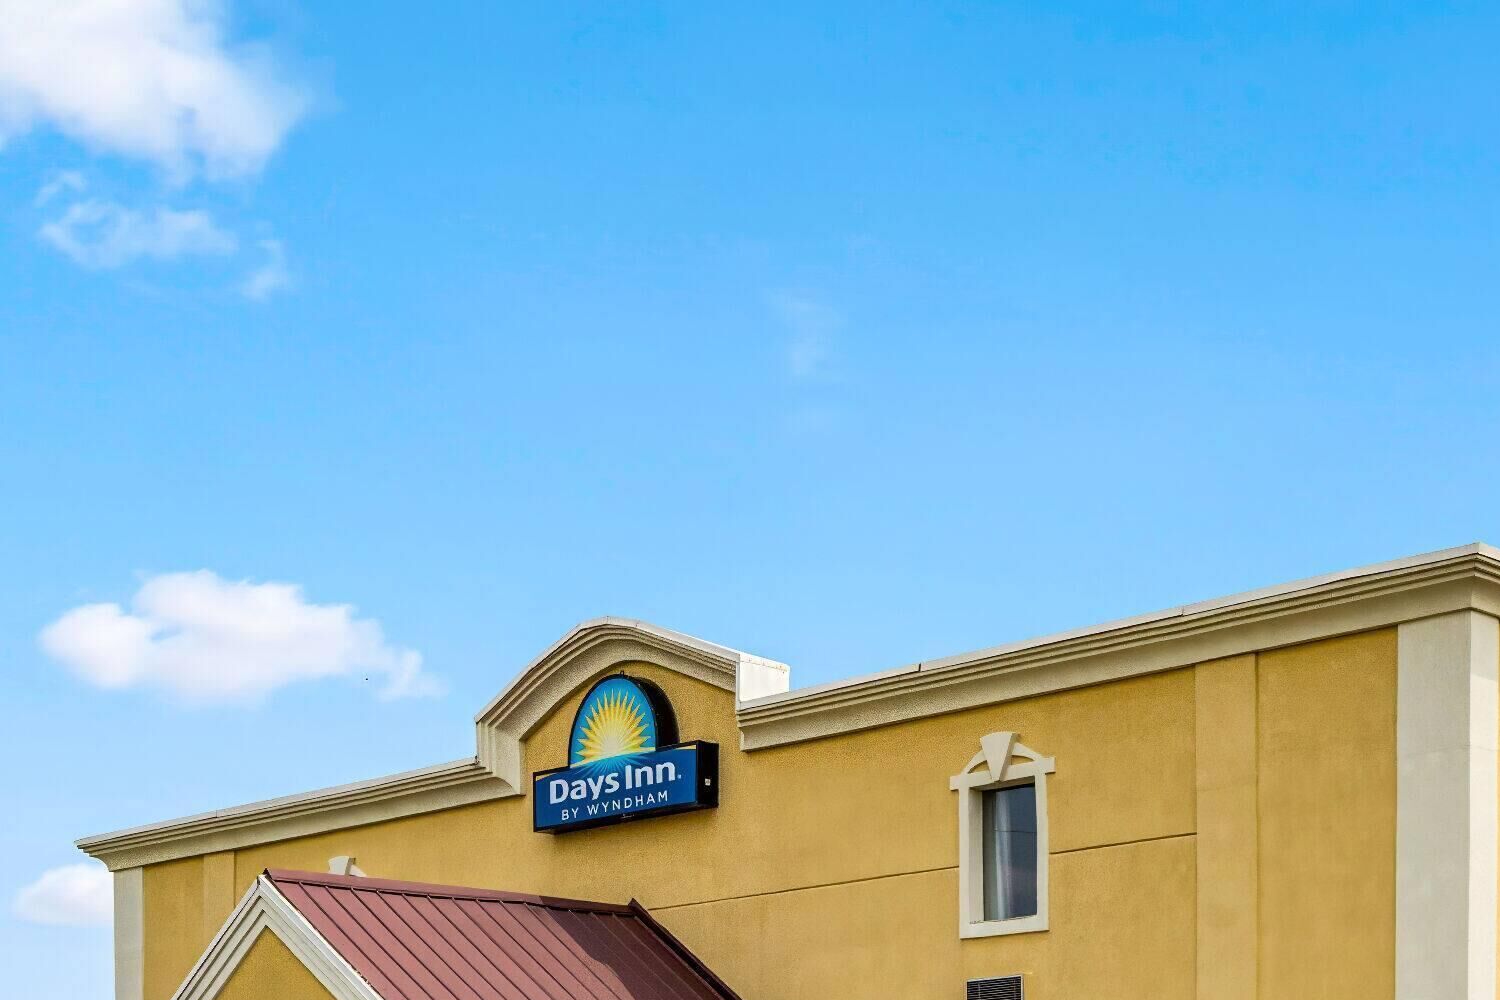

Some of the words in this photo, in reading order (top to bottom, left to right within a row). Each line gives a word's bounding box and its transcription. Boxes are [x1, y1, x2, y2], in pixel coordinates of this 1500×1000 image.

[550, 773, 620, 804] Days
[561, 807, 579, 821] BY
[587, 790, 668, 816] WYNDHAM
